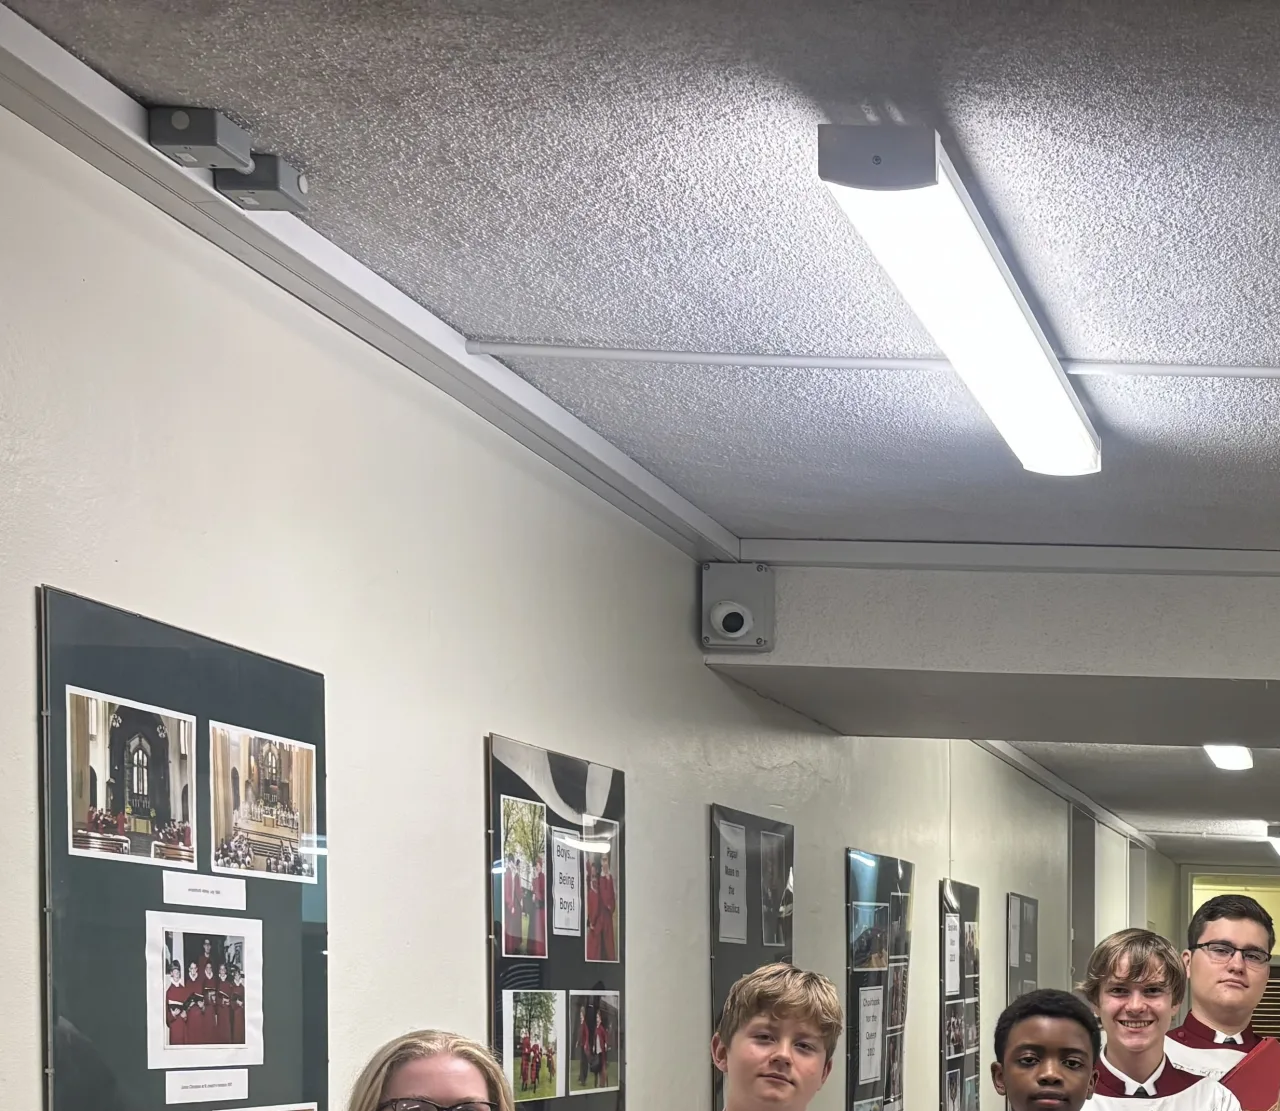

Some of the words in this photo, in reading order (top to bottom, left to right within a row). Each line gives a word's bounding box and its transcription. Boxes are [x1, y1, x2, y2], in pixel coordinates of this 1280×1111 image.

[725, 864, 735, 877] Mass
[559, 872, 575, 889] Being
[560, 897, 575, 913] Boys!
[724, 901, 740, 914] Basilica
[866, 1031, 877, 1040] Queen
